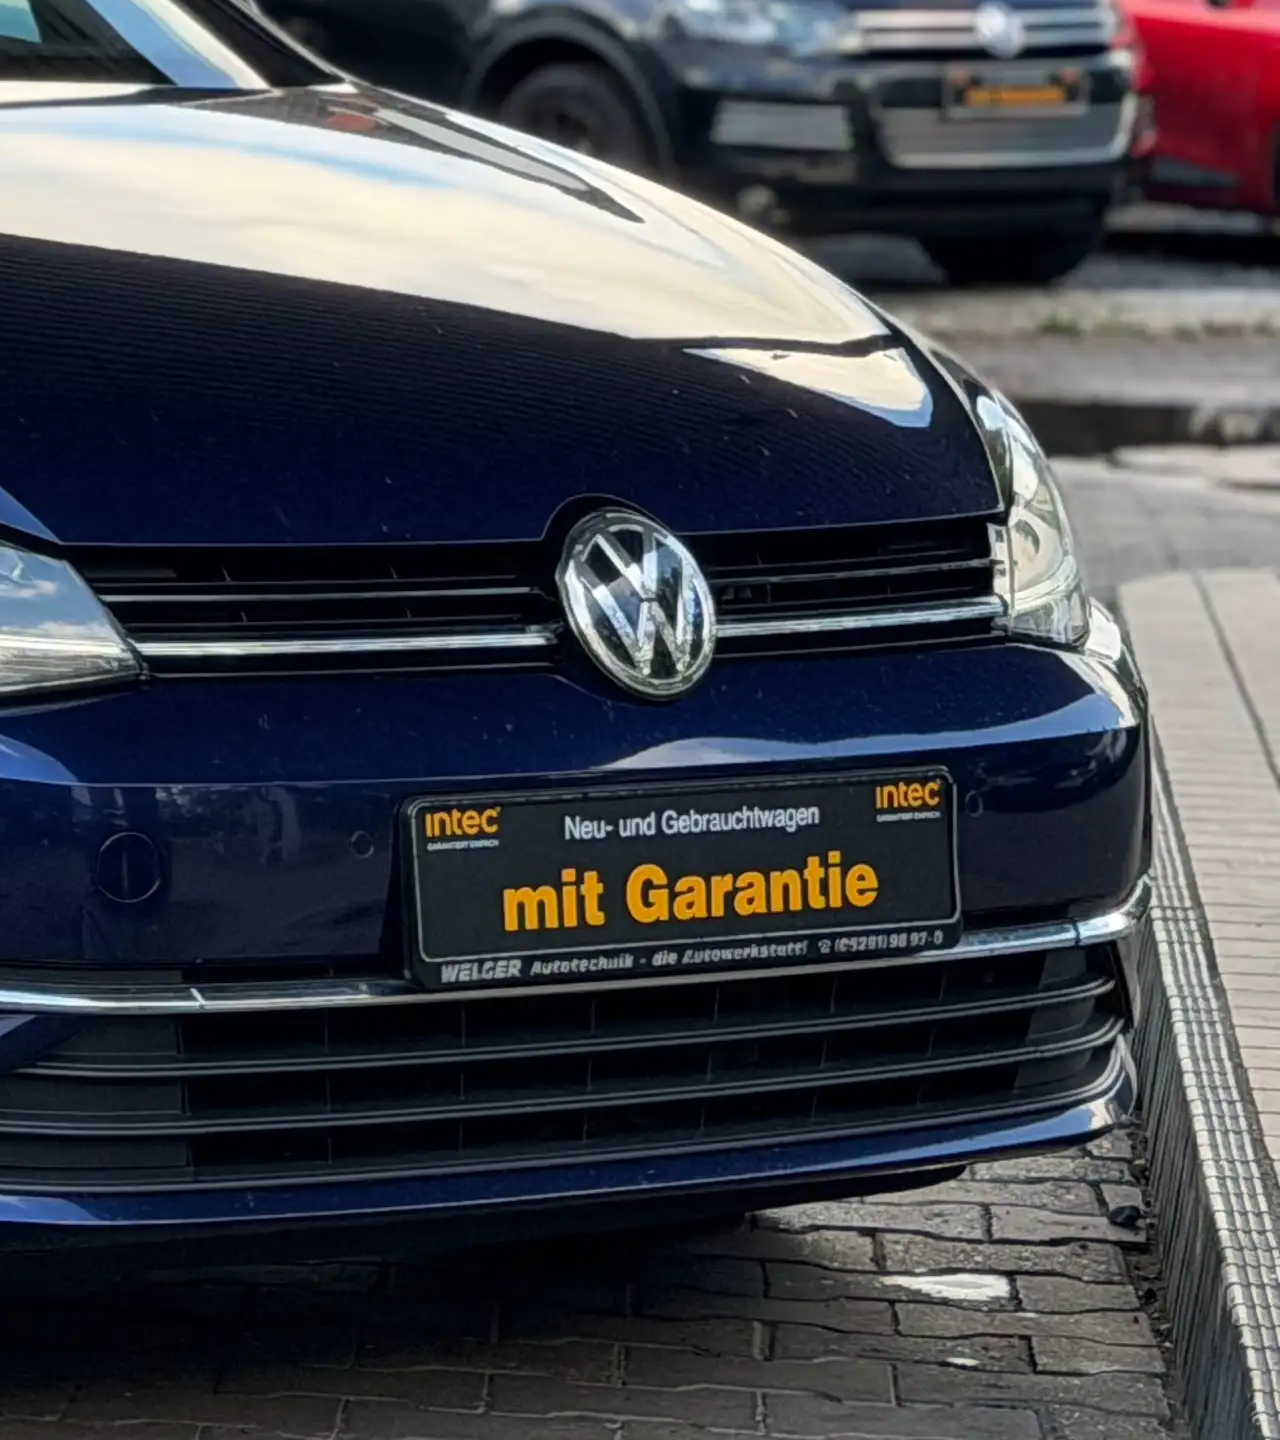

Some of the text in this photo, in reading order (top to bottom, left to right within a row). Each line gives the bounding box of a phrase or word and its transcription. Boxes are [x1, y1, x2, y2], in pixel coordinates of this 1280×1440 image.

[564, 804, 820, 840] Neu- und Gebrauchtwagen
[502, 850, 879, 932] mit Garantie
[440, 959, 522, 983] WELGER
[530, 953, 634, 976] Autotechnik
[652, 950, 677, 966] die
